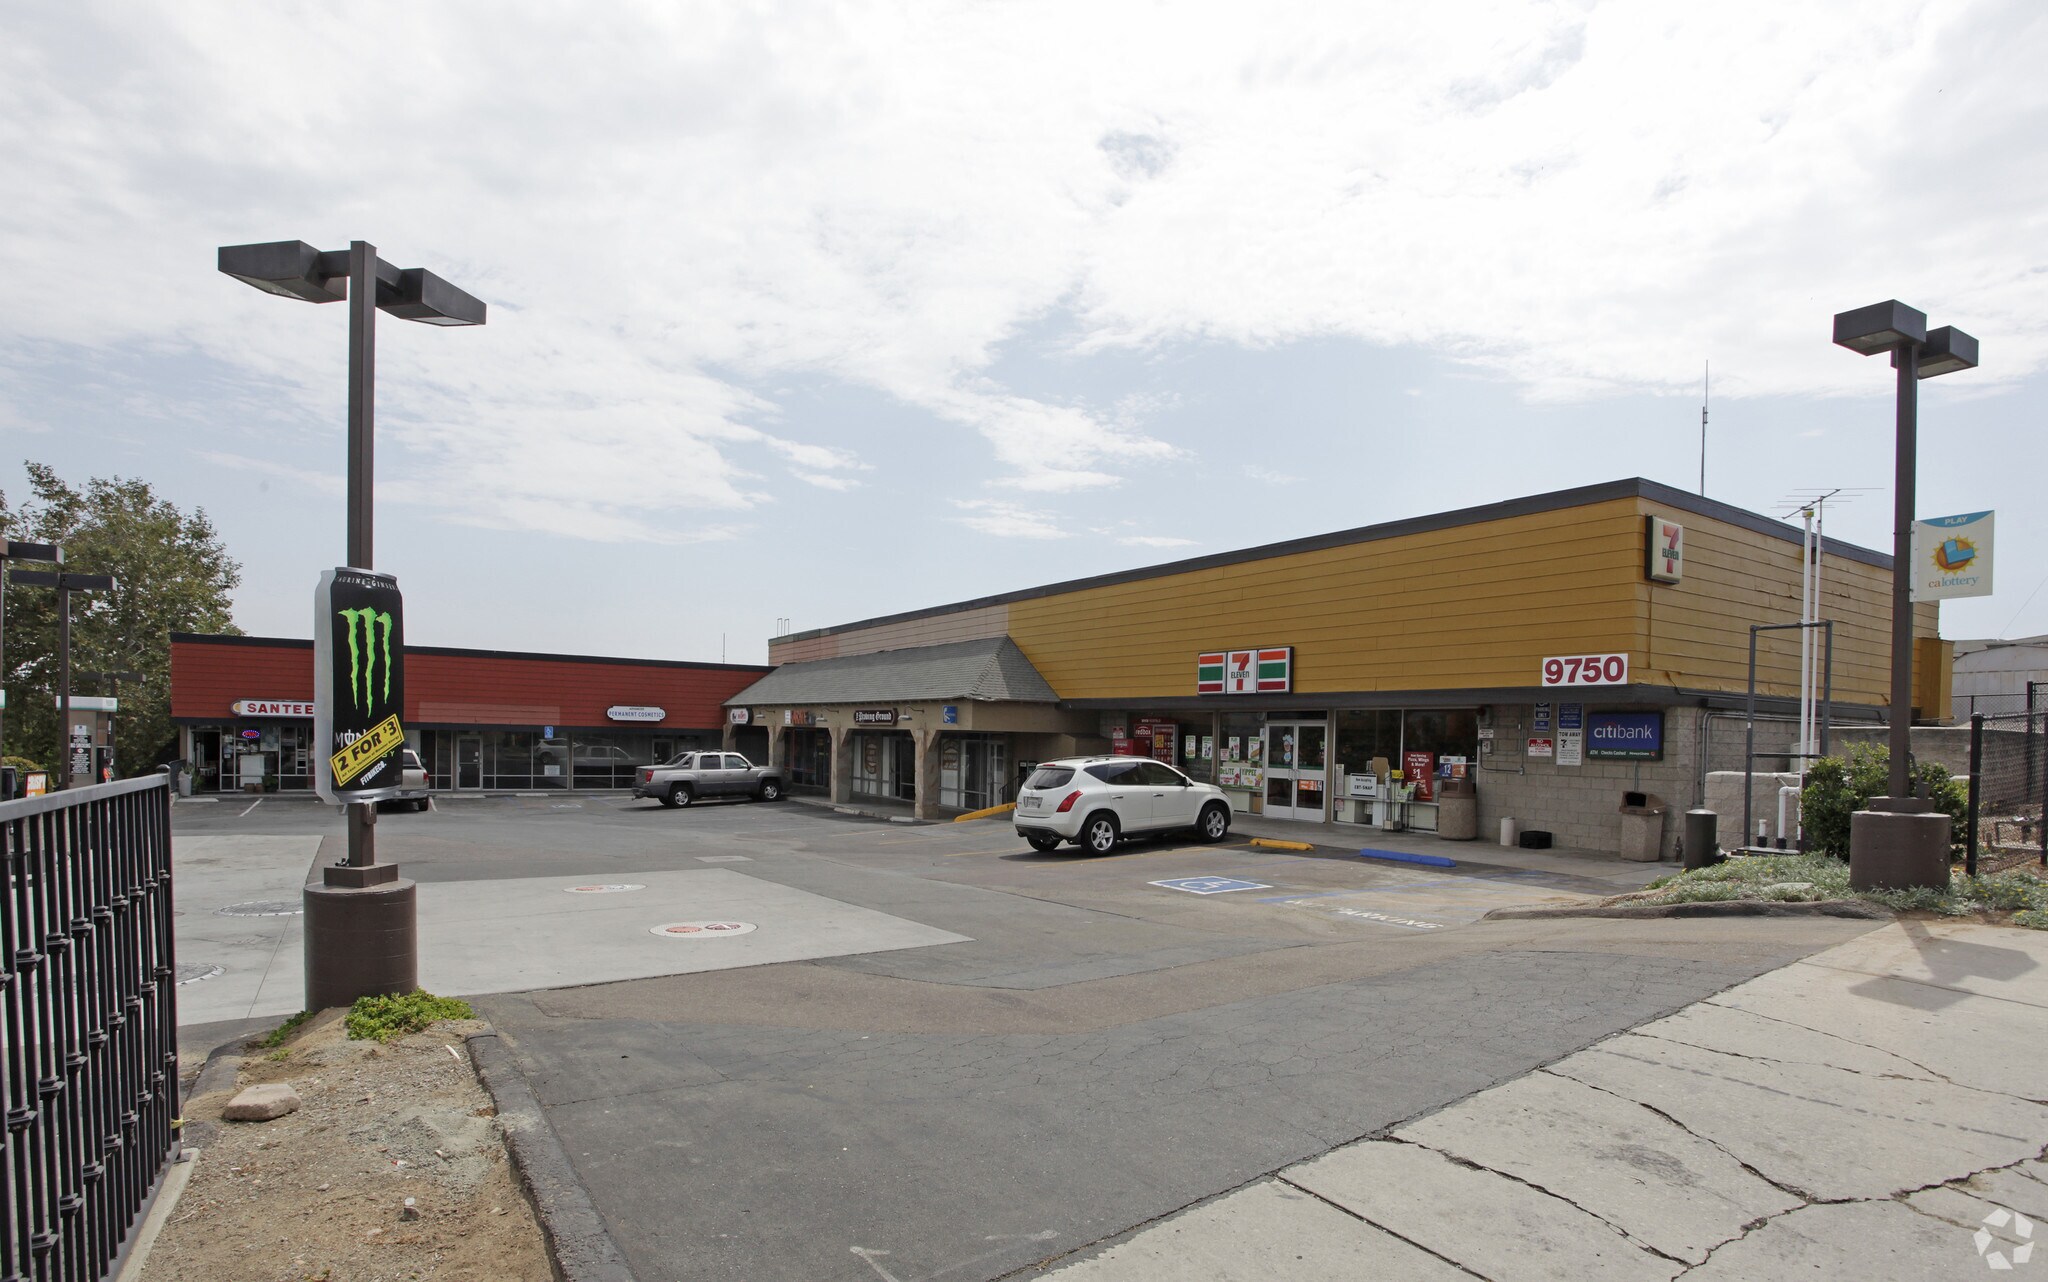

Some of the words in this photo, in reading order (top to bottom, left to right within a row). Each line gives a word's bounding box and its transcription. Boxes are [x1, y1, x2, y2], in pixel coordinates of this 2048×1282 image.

[1944, 516, 1968, 525] PLAY
[1544, 656, 1625, 685] 9750
[247, 703, 314, 714] SANTEE
[1593, 724, 1653, 739] citibank
[337, 755, 349, 772] 2
[351, 731, 382, 762] FOR
